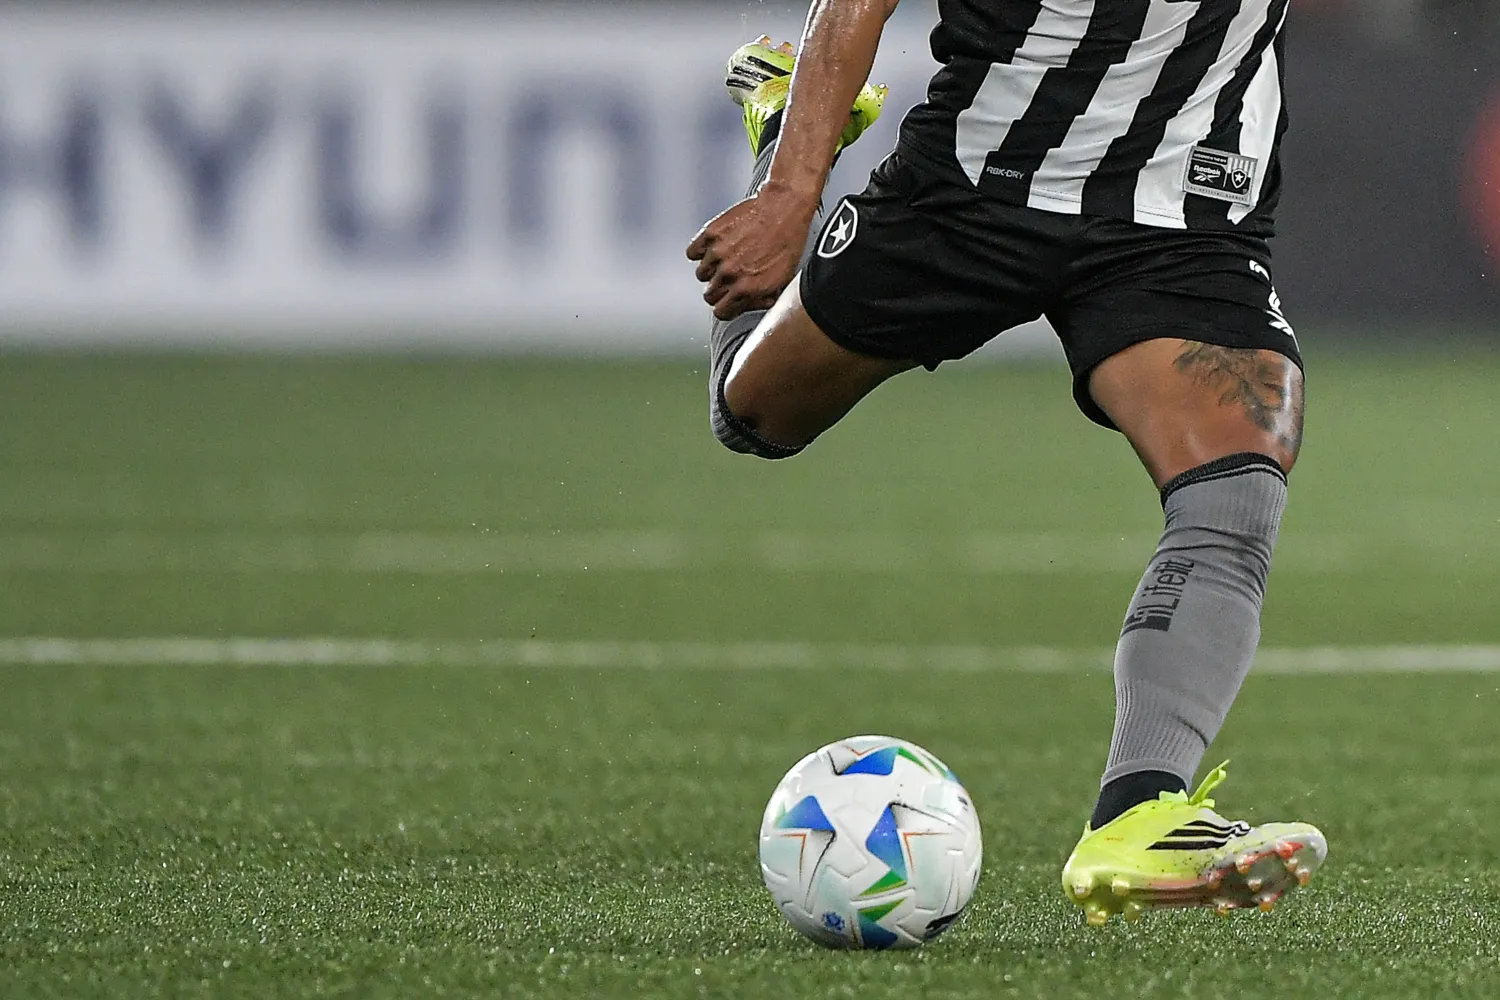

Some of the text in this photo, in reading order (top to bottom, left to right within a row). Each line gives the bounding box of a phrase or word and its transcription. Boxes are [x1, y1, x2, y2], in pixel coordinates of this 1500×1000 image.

[0, 62, 765, 268] HYUN
[1193, 164, 1222, 177] Reebok
[986, 166, 1025, 180] RBK-DRY
